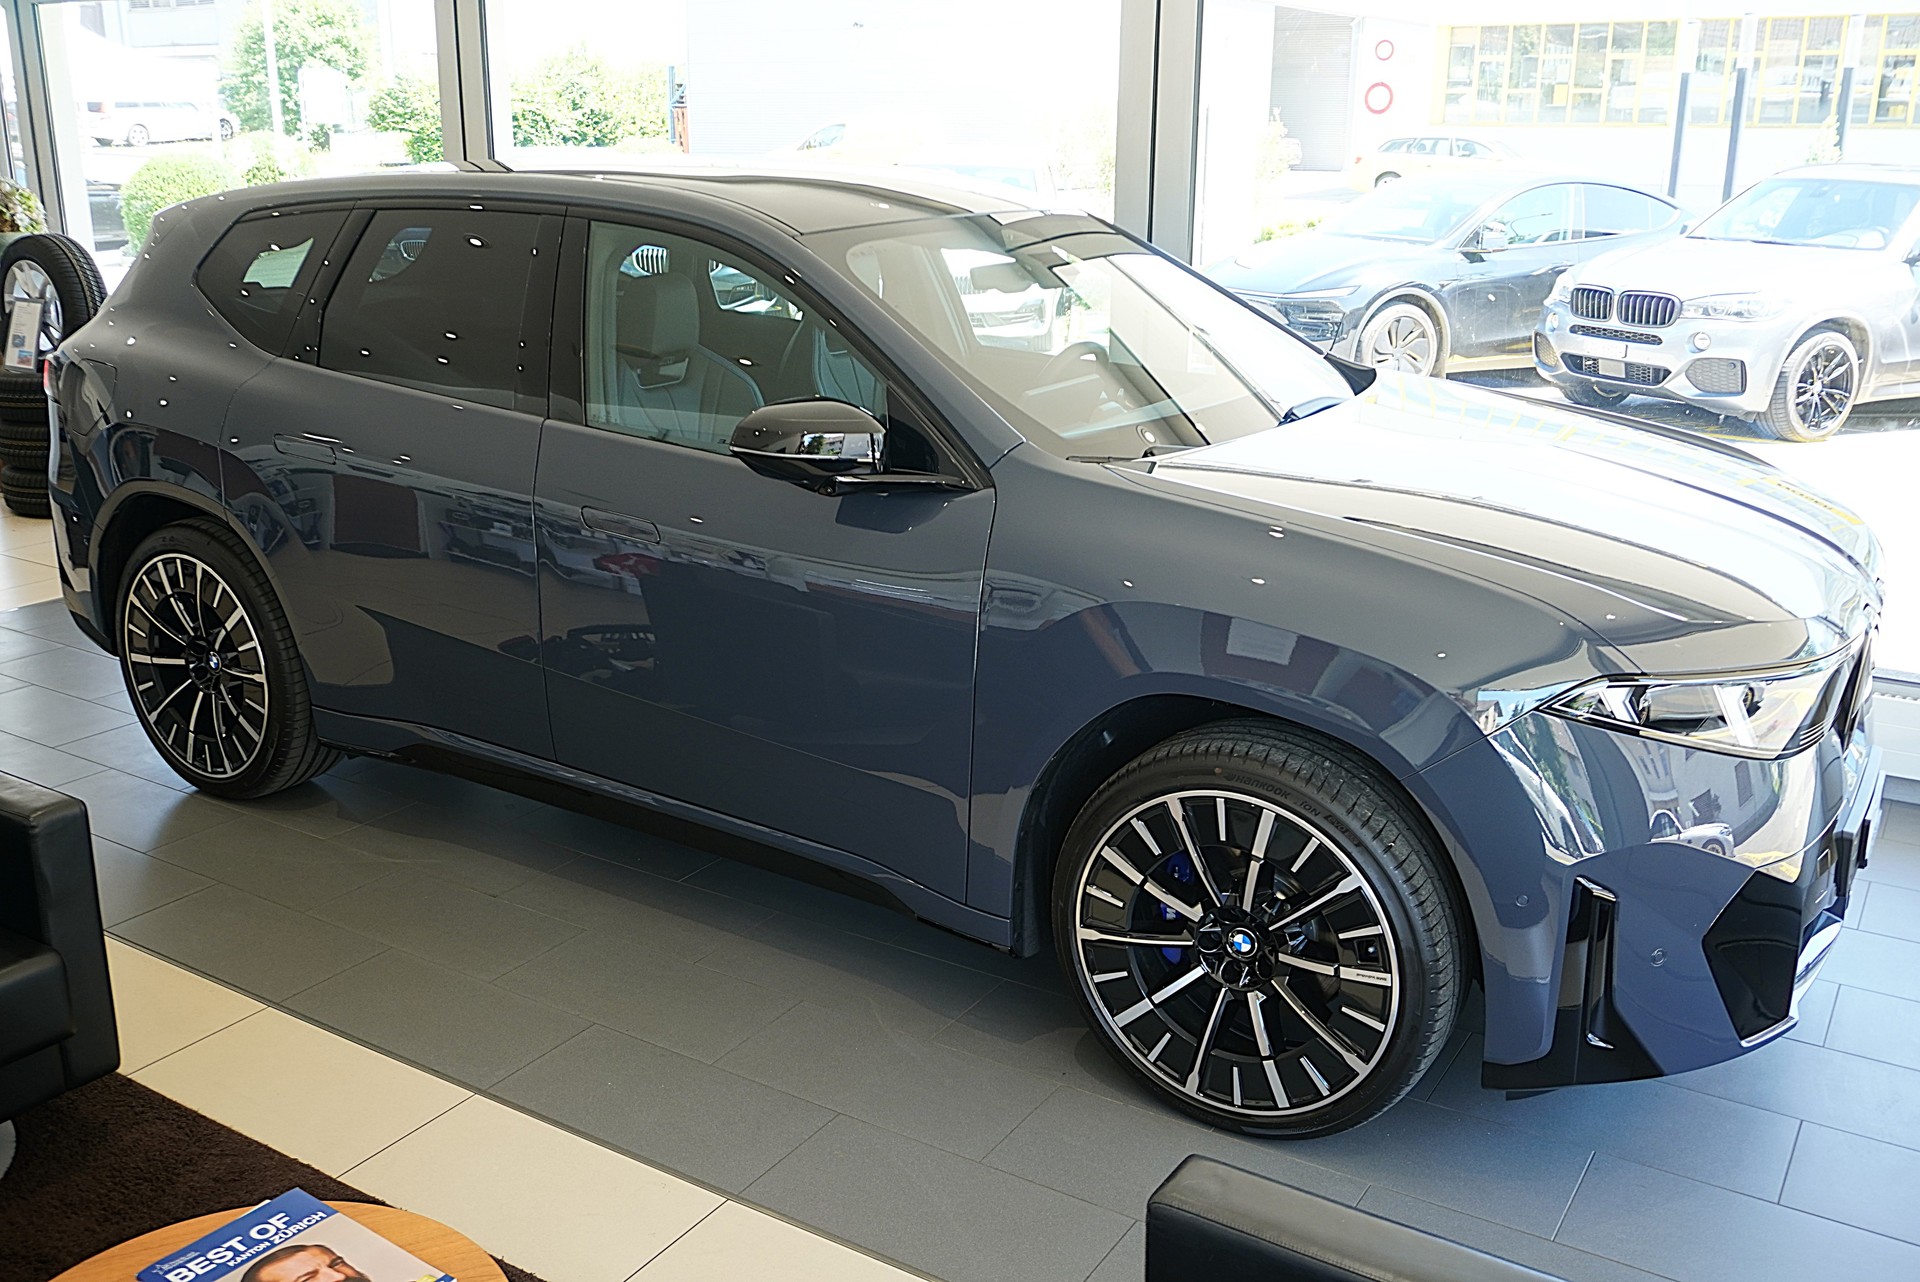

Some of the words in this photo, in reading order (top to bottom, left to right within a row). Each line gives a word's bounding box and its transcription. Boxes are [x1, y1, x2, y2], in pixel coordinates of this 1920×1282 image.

[164, 1236, 243, 1282] BEST
[249, 1212, 291, 1240] OF
[226, 1241, 271, 1267] KANTON
[271, 1211, 327, 1244] ZÜRICH
